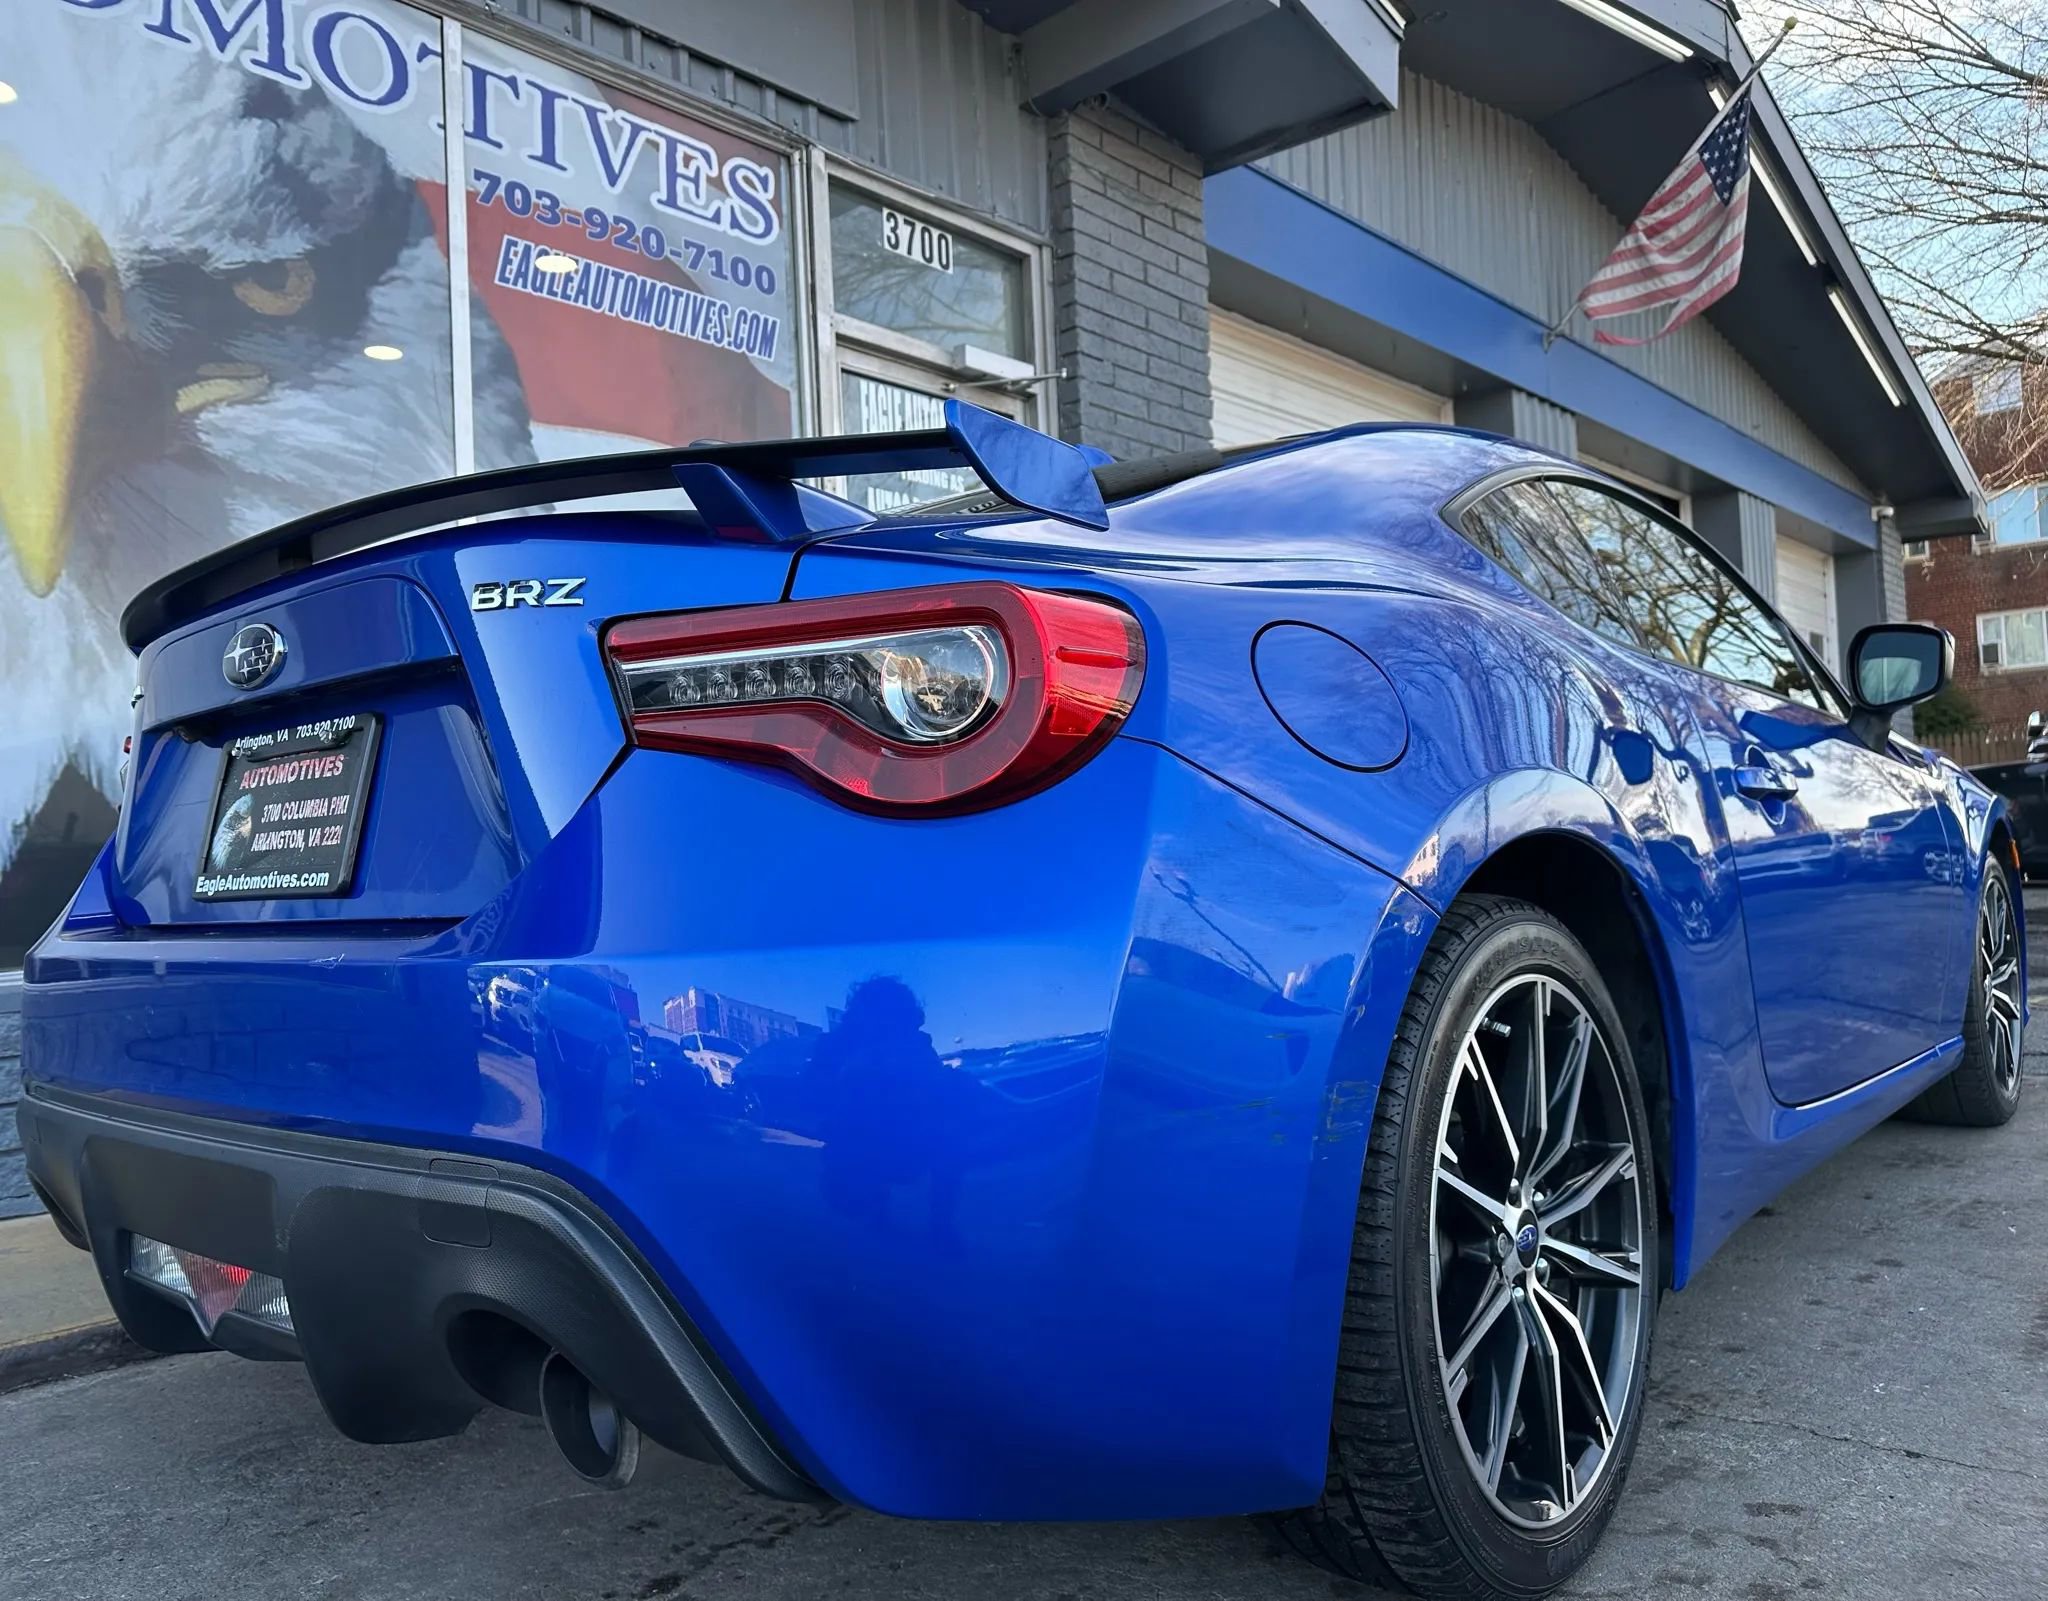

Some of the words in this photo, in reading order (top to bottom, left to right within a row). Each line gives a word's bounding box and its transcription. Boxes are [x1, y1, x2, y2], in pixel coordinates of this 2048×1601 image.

[62, 0, 776, 240] MOTIVES
[473, 168, 776, 295] 703-920-7100
[886, 211, 950, 271] 3700
[496, 236, 778, 360] EAGLEAUTOMOTIVES.COM
[471, 578, 586, 611] BRZ
[234, 734, 274, 750] Arlington,
[277, 728, 289, 742] VA
[239, 754, 344, 789] AUTOMOTIVES
[261, 803, 282, 823] 3700
[281, 798, 328, 820] COLUMBIA
[250, 829, 305, 852] ARLINGTON,
[308, 828, 322, 847] VA
[196, 871, 330, 896] EagleAutomotives.com
